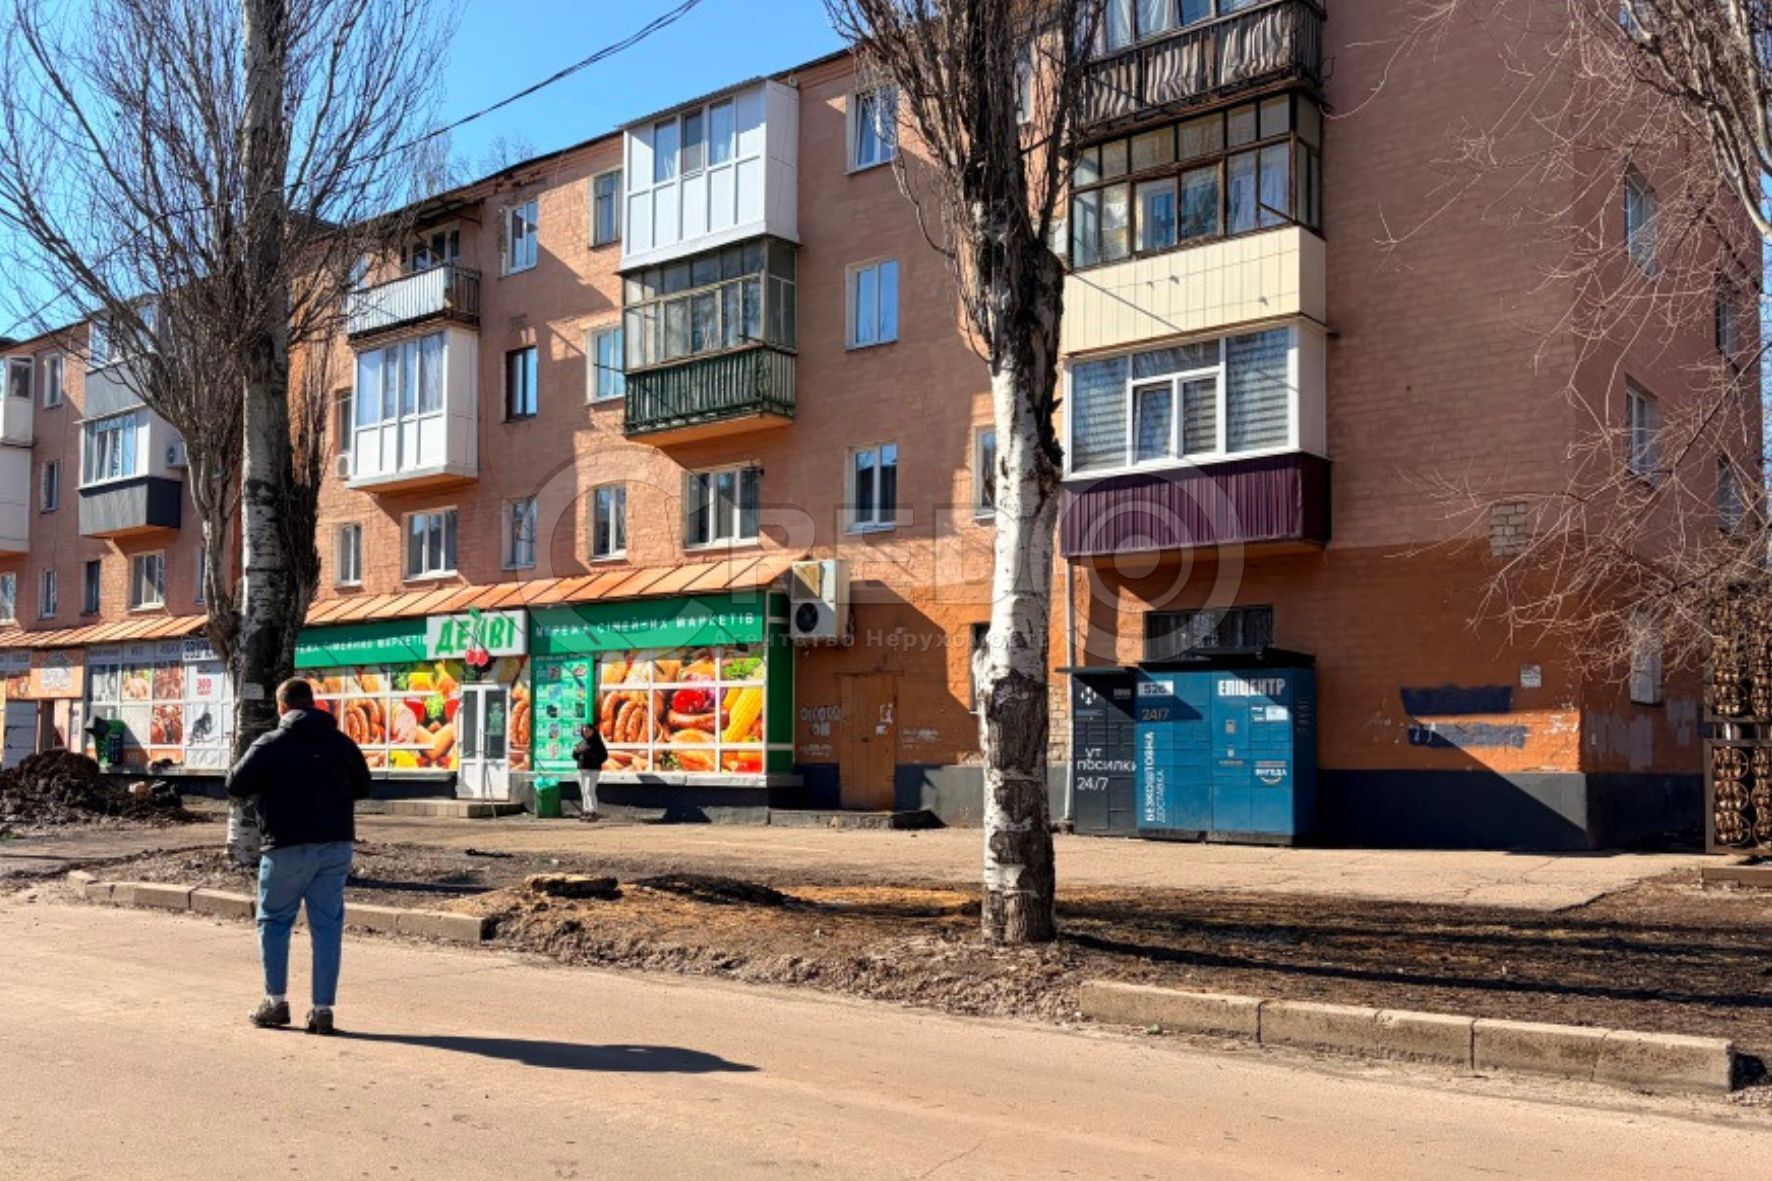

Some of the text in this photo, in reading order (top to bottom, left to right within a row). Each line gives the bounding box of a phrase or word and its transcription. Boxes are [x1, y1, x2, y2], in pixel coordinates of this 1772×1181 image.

[675, 612, 754, 629] МАРКЕТІВ
[1218, 679, 1285, 697] ЕПІЦЕНТР
[1142, 707, 1169, 720] 24/7
[1077, 777, 1109, 791] 24/7
